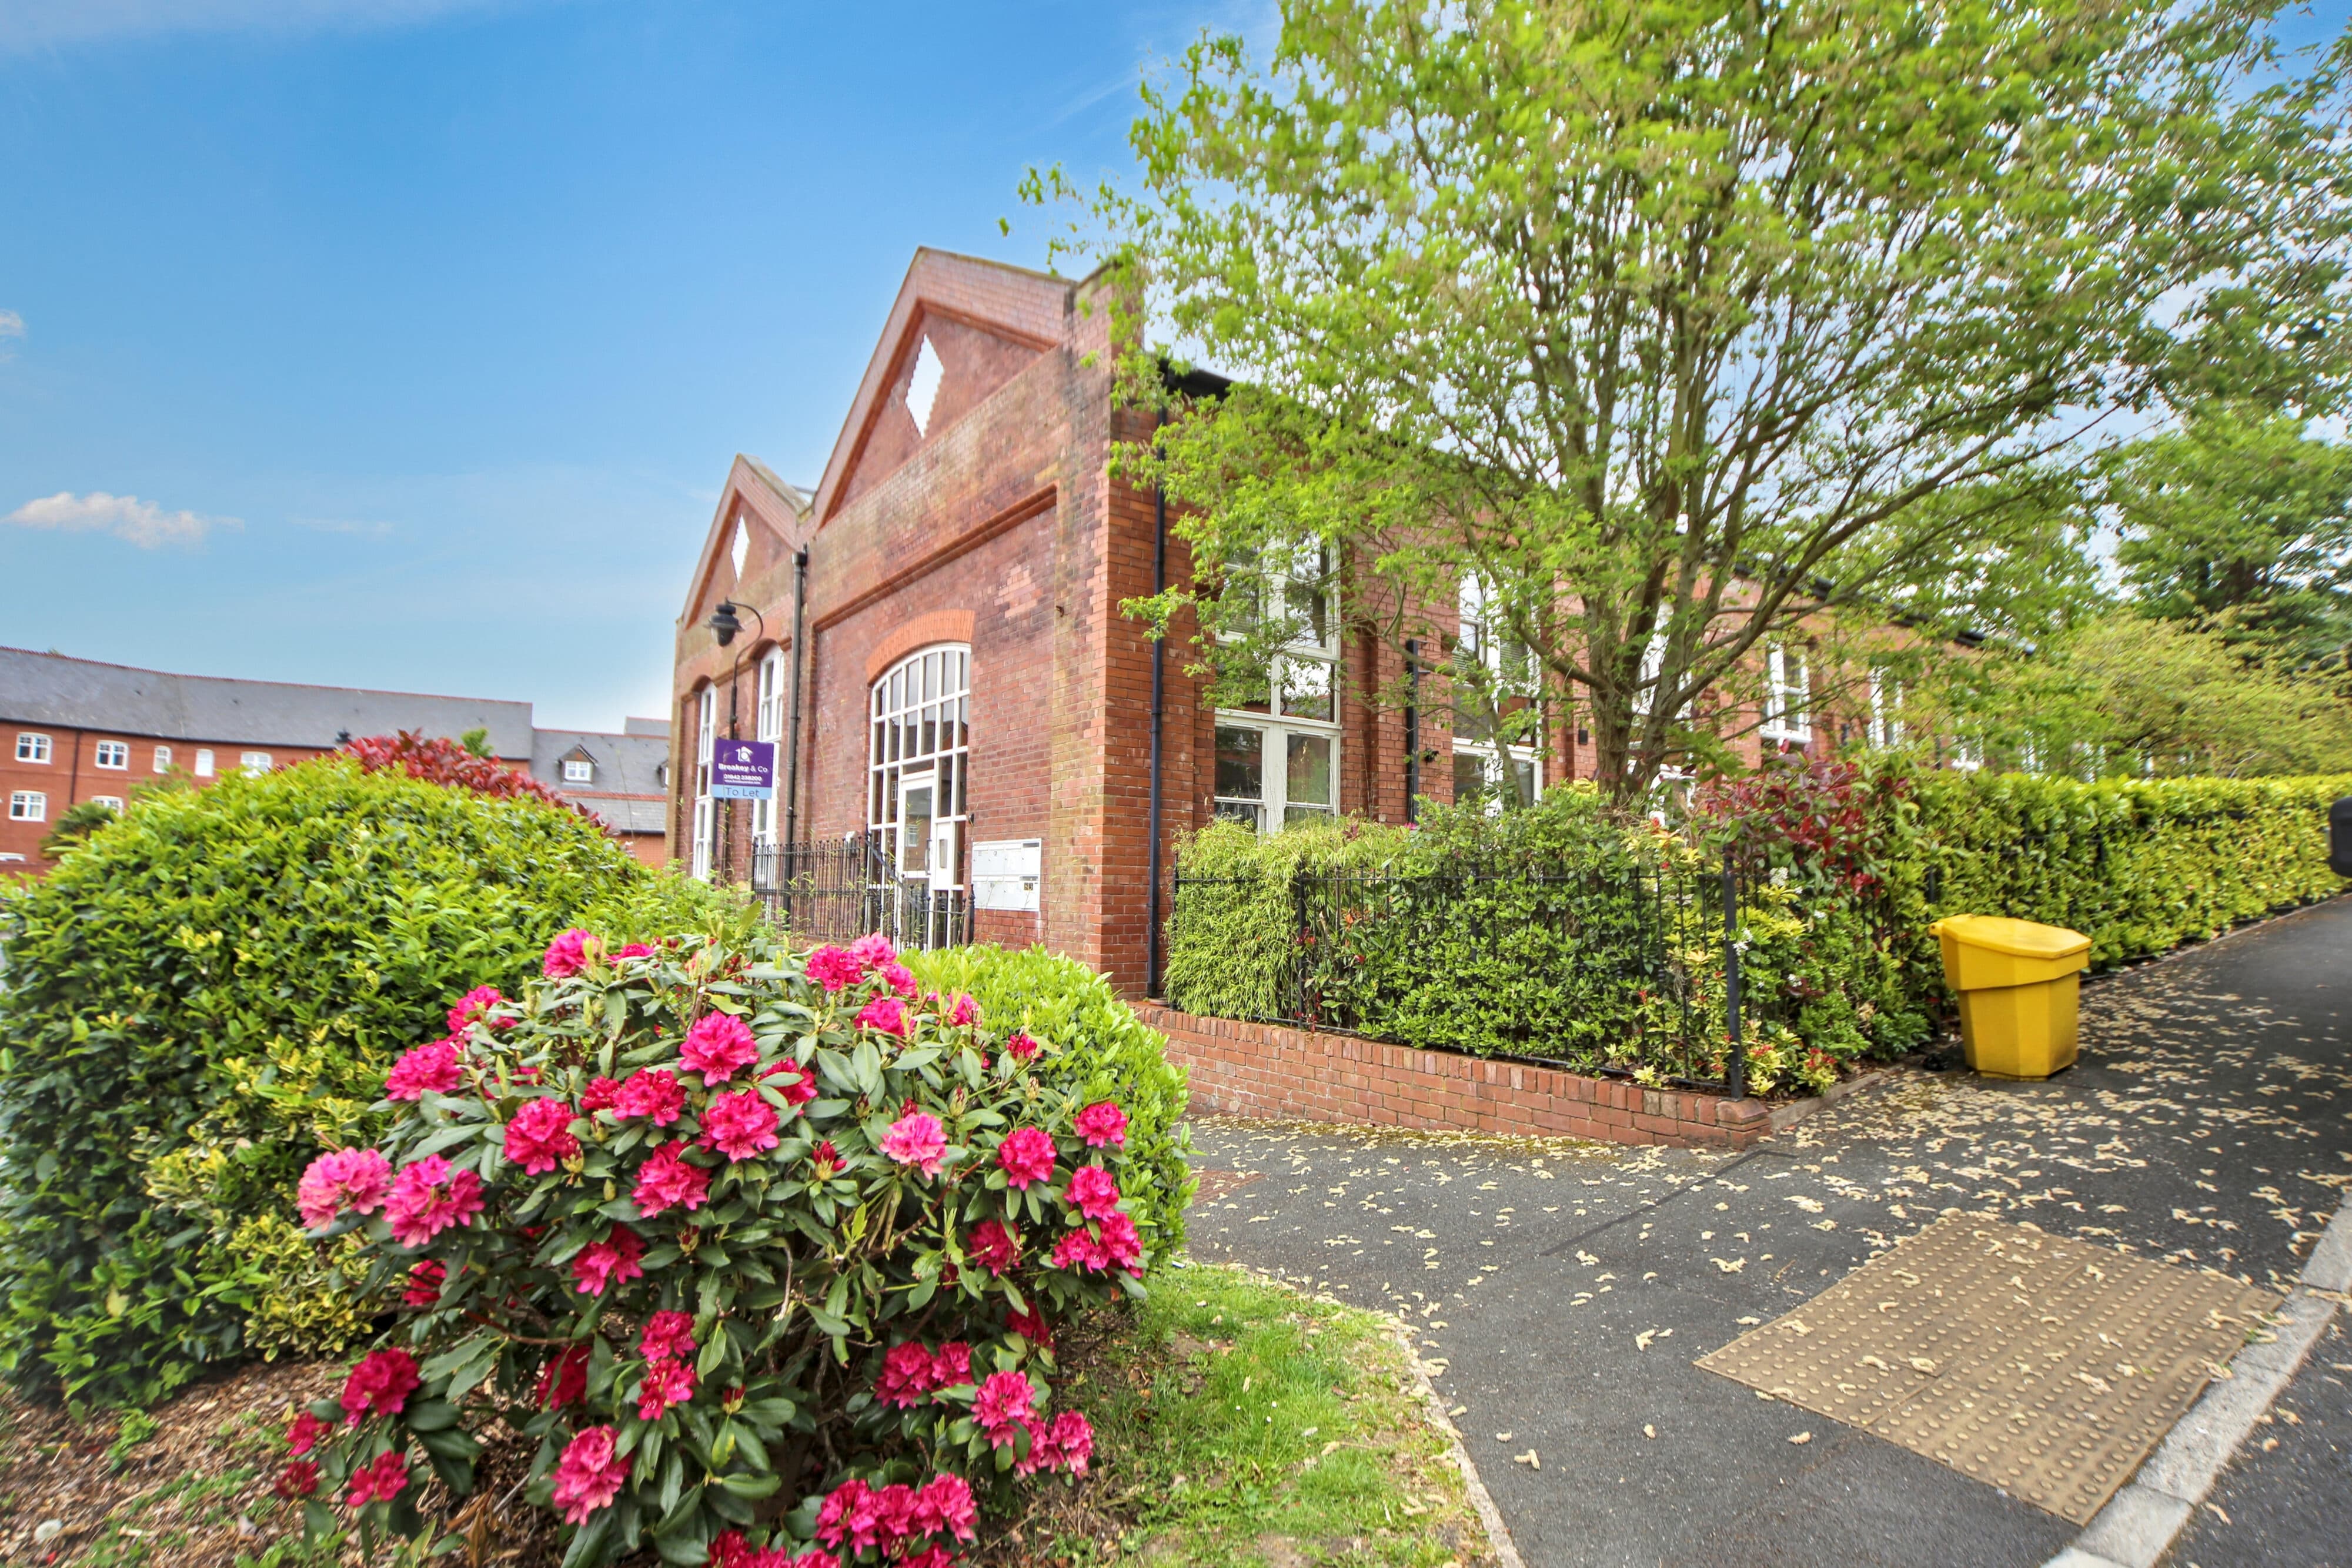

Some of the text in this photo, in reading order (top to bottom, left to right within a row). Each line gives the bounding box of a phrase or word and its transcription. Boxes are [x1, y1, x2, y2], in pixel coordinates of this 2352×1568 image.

[718, 763, 749, 772] Breakey
[726, 787, 760, 797] To Let
